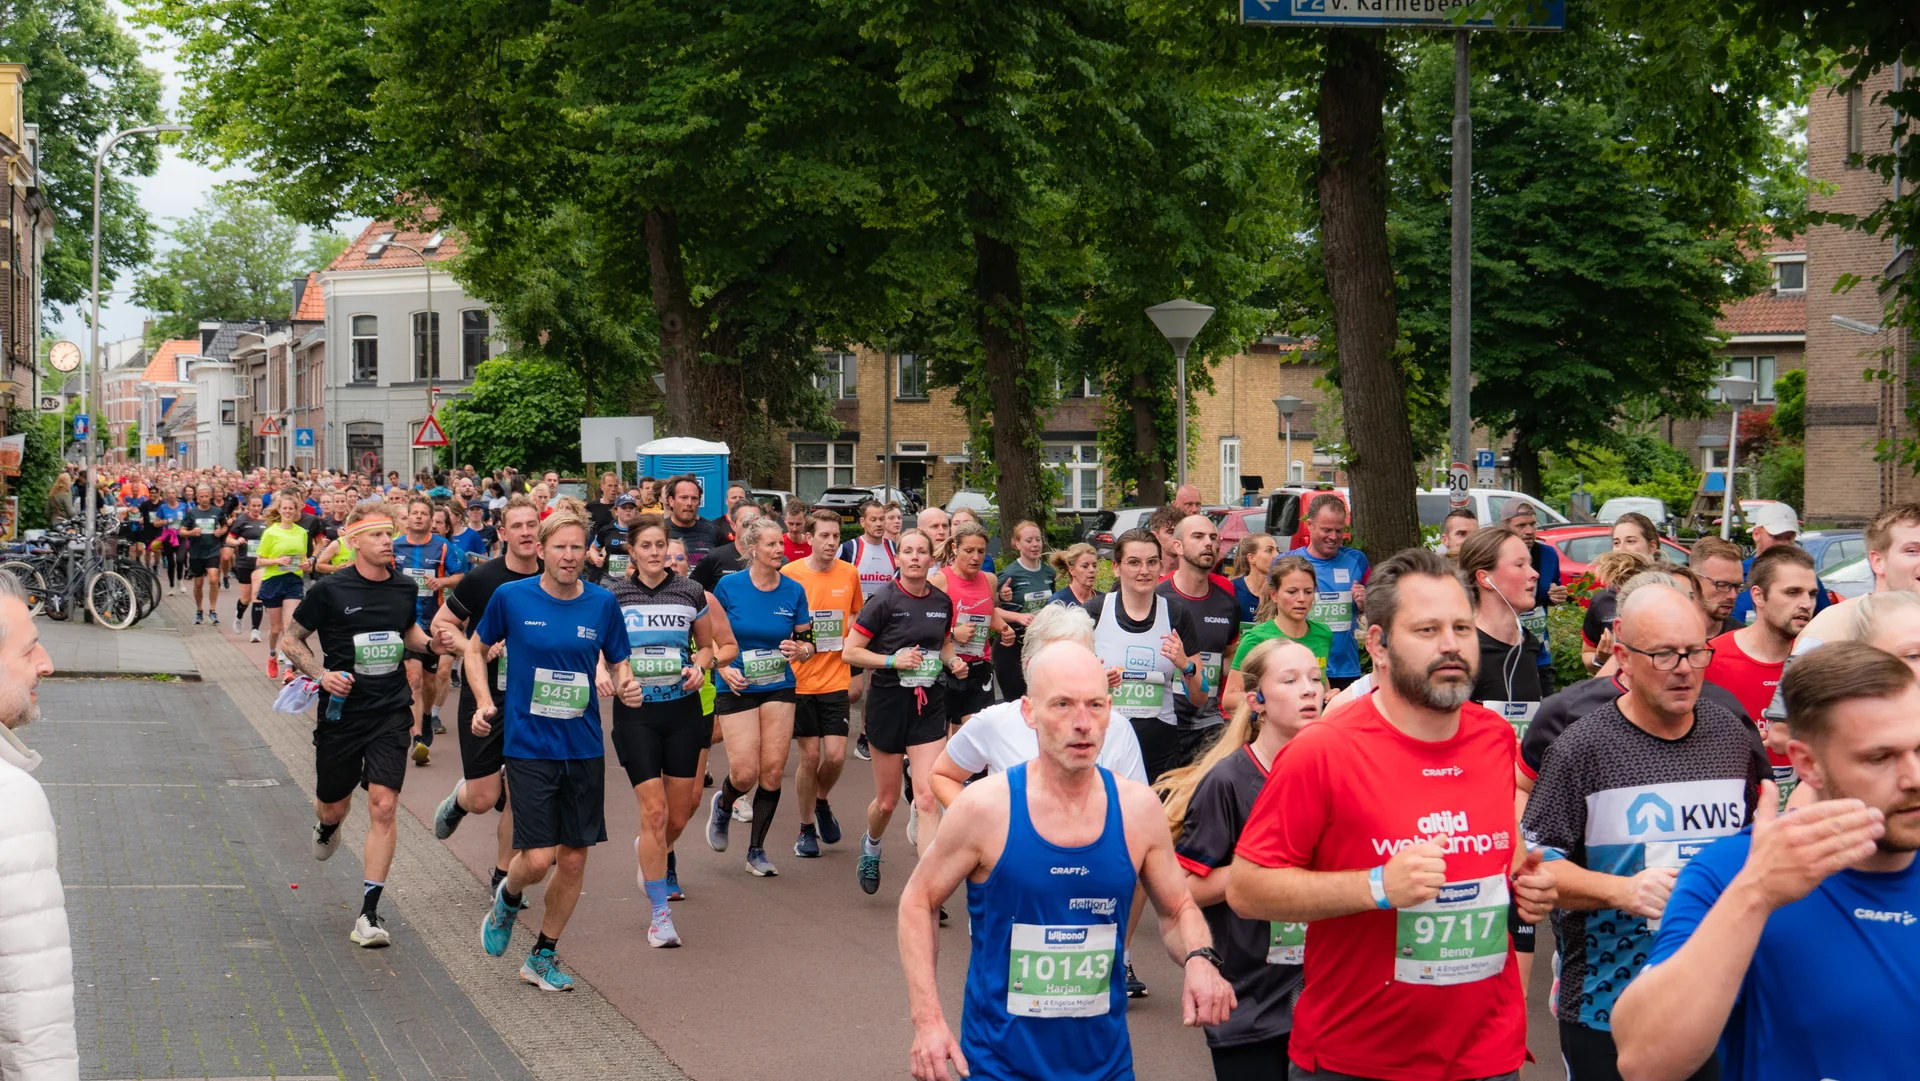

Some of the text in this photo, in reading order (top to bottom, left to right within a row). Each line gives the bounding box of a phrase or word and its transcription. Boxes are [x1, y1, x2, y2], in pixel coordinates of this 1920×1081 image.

[1481, 453, 1492, 466] P
[1450, 474, 1468, 491] 30
[1314, 604, 1347, 616] 9786
[648, 614, 686, 627] KWS
[1204, 616, 1229, 624] SCANIA
[362, 645, 397, 659] 9052
[636, 660, 674, 672] 8810
[750, 659, 780, 672] 9820
[541, 684, 580, 700] 9451
[1112, 684, 1154, 698] 8708
[549, 699, 570, 707] Martijn
[1422, 767, 1453, 776] CRAFT
[1417, 810, 1469, 836] altijd
[1681, 802, 1741, 831] KWS
[1050, 867, 1081, 875] CRAFT
[1071, 899, 1107, 909] deltion
[1854, 908, 1903, 923] CRAFT
[1414, 911, 1496, 944] 9717
[1517, 925, 1534, 934] JAKO
[1048, 930, 1085, 942] Wijzonol
[1440, 947, 1475, 958] Benny
[1017, 953, 1109, 980] 10143
[1046, 983, 1081, 995] Harjan
